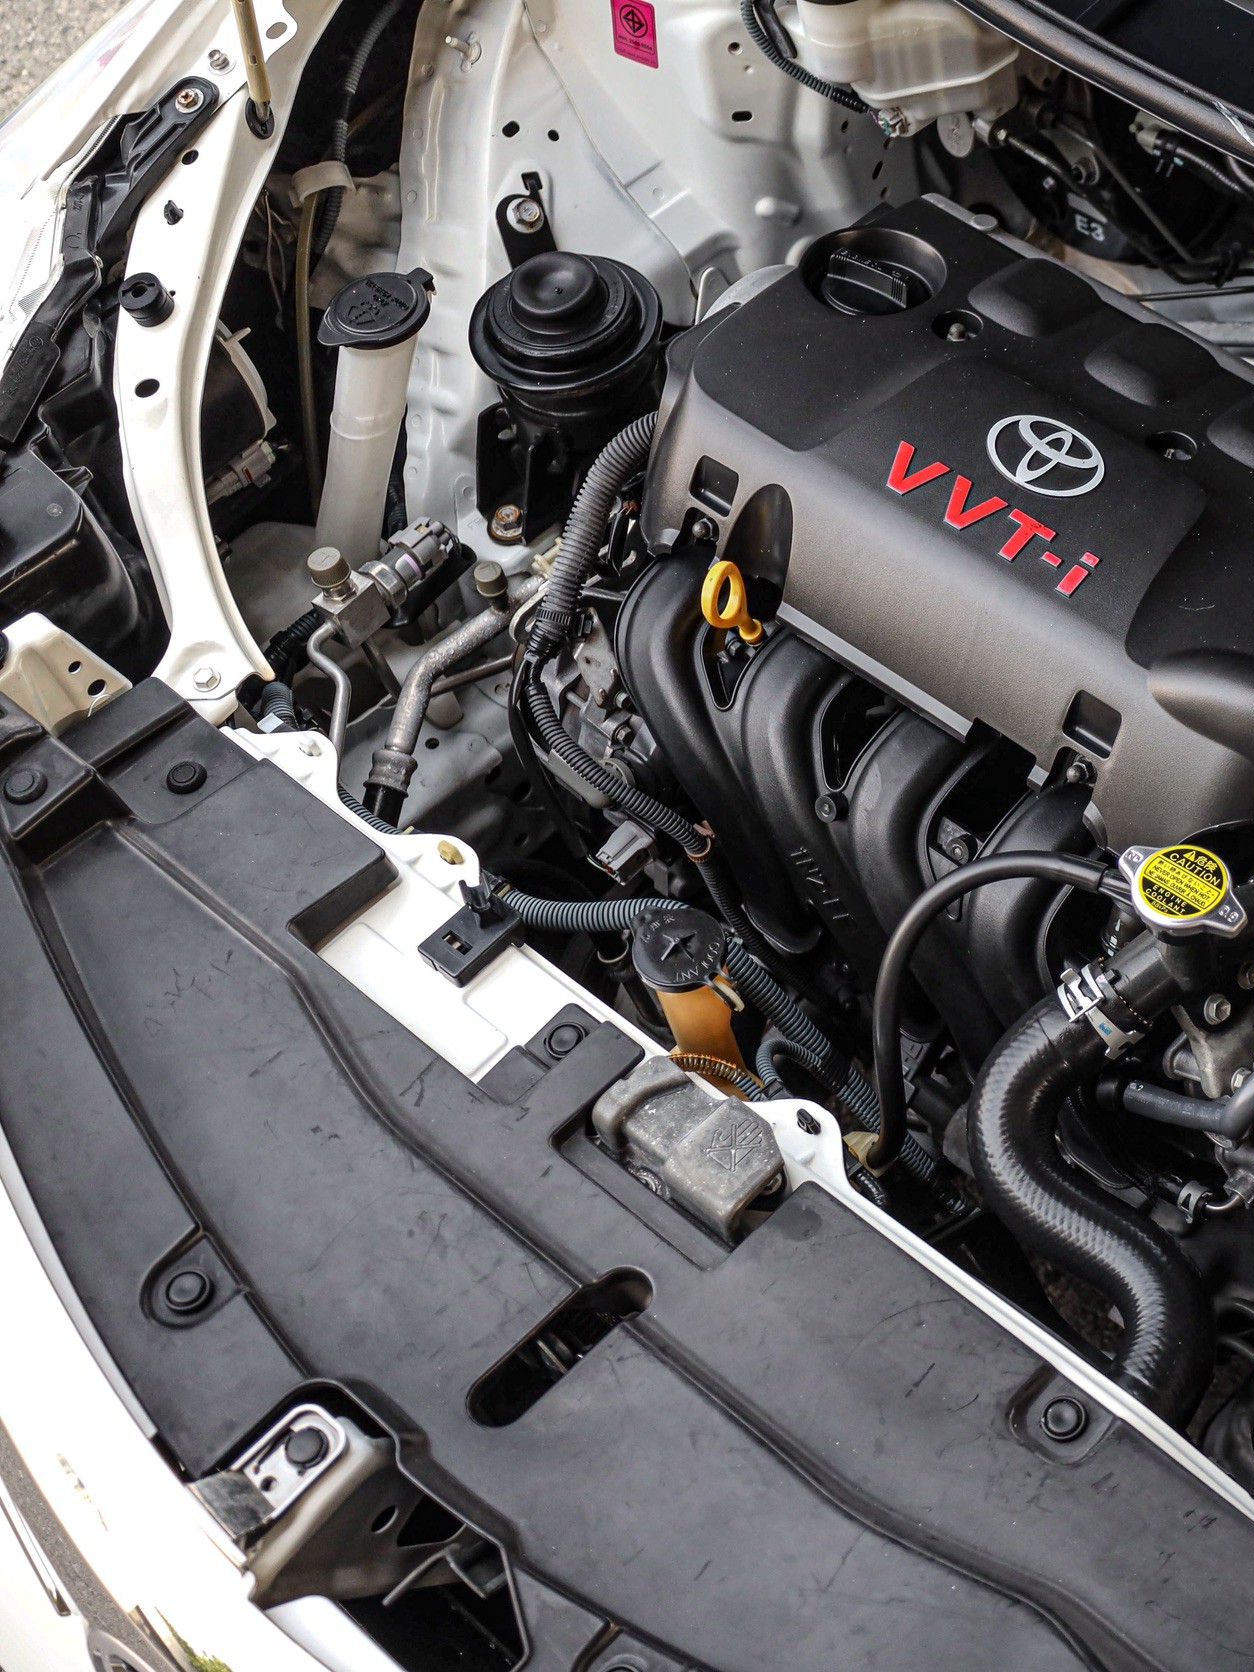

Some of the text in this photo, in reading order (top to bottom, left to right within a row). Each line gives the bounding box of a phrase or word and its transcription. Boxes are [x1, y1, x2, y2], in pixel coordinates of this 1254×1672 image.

[1075, 213, 1106, 242] E3
[885, 440, 1102, 598] VVT-i
[1152, 865, 1171, 878] NEVER
[1169, 874, 1184, 885] OPEN
[1183, 883, 1200, 894] WHEN
[1169, 852, 1220, 886] CAUTION
[1145, 888, 1186, 914] COOLANT
[1152, 885, 1188, 908] ENGINE
